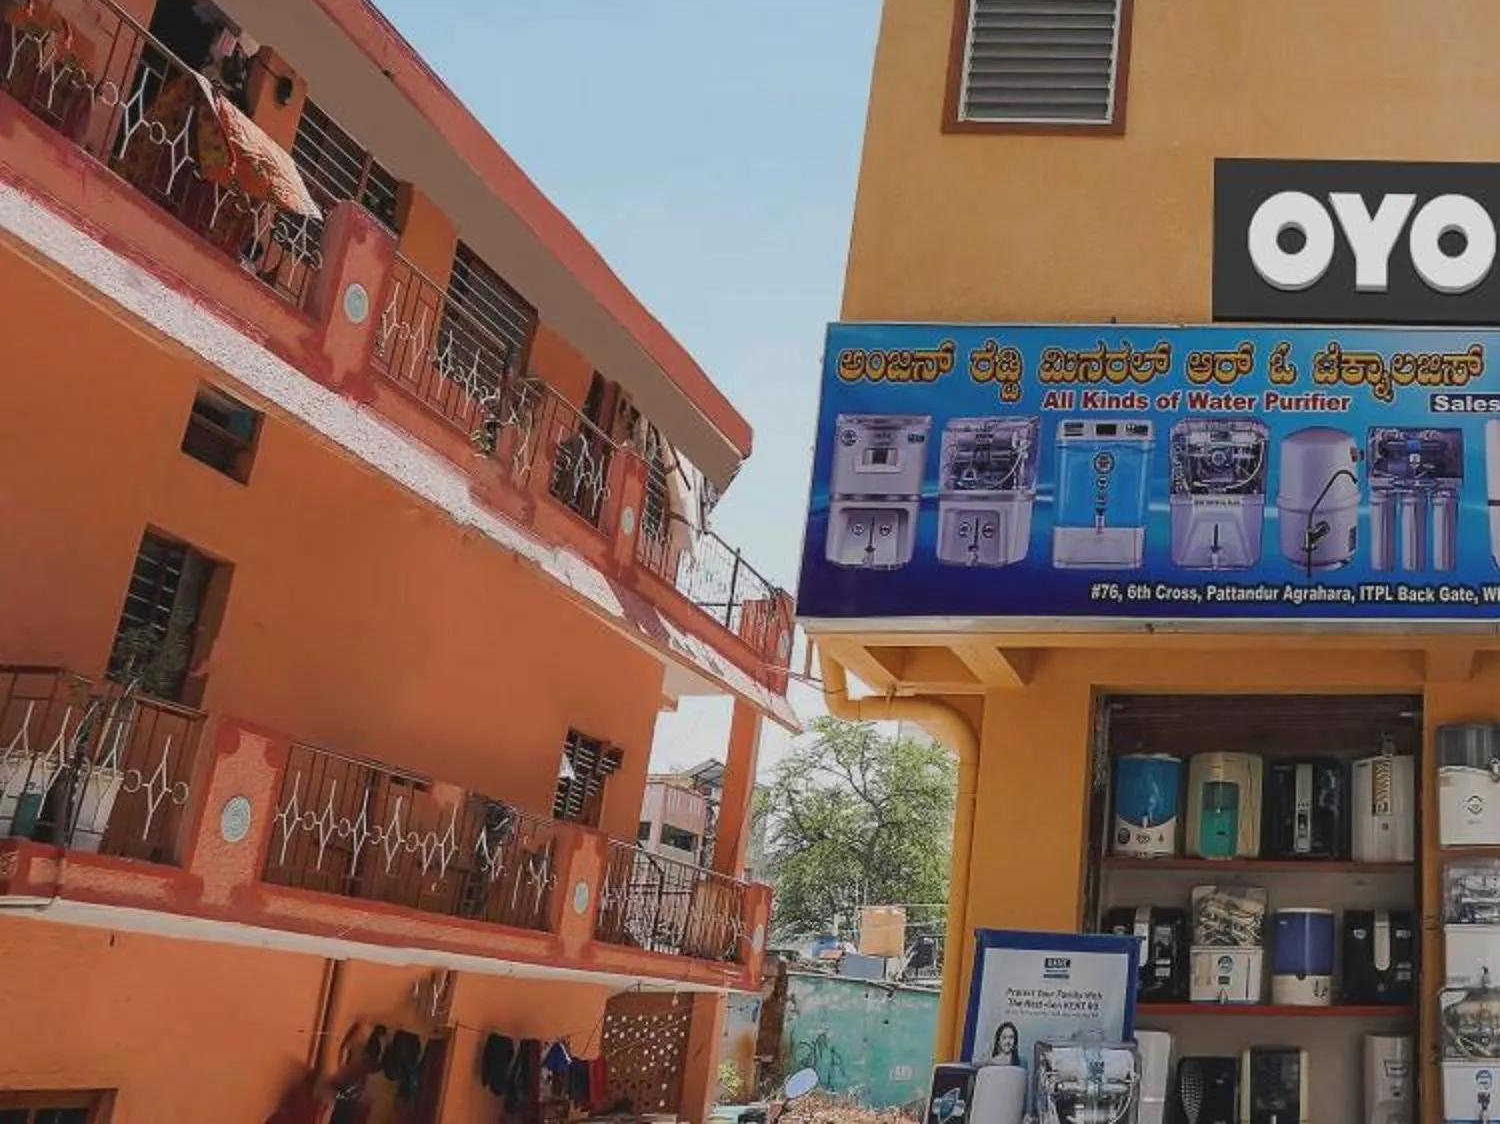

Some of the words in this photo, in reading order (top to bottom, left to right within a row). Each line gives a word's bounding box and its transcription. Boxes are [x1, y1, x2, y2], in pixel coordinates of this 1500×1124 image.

[1248, 191, 1497, 295] OYO
[1042, 392, 1074, 409] All
[1082, 392, 1148, 409] Kinds
[1156, 392, 1180, 410] of
[1187, 393, 1256, 411] Water
[1265, 392, 1351, 412] Purifier
[1434, 395, 1500, 411] Sales
[1091, 584, 1123, 601] #76,
[1127, 584, 1151, 599] 6th
[1155, 585, 1201, 602] Cross,
[1207, 585, 1279, 601] Pattandur
[1283, 586, 1355, 604] Agrahara,
[1360, 586, 1394, 601] ITPL
[1398, 586, 1435, 602] Back
[1439, 588, 1479, 605] Gate,
